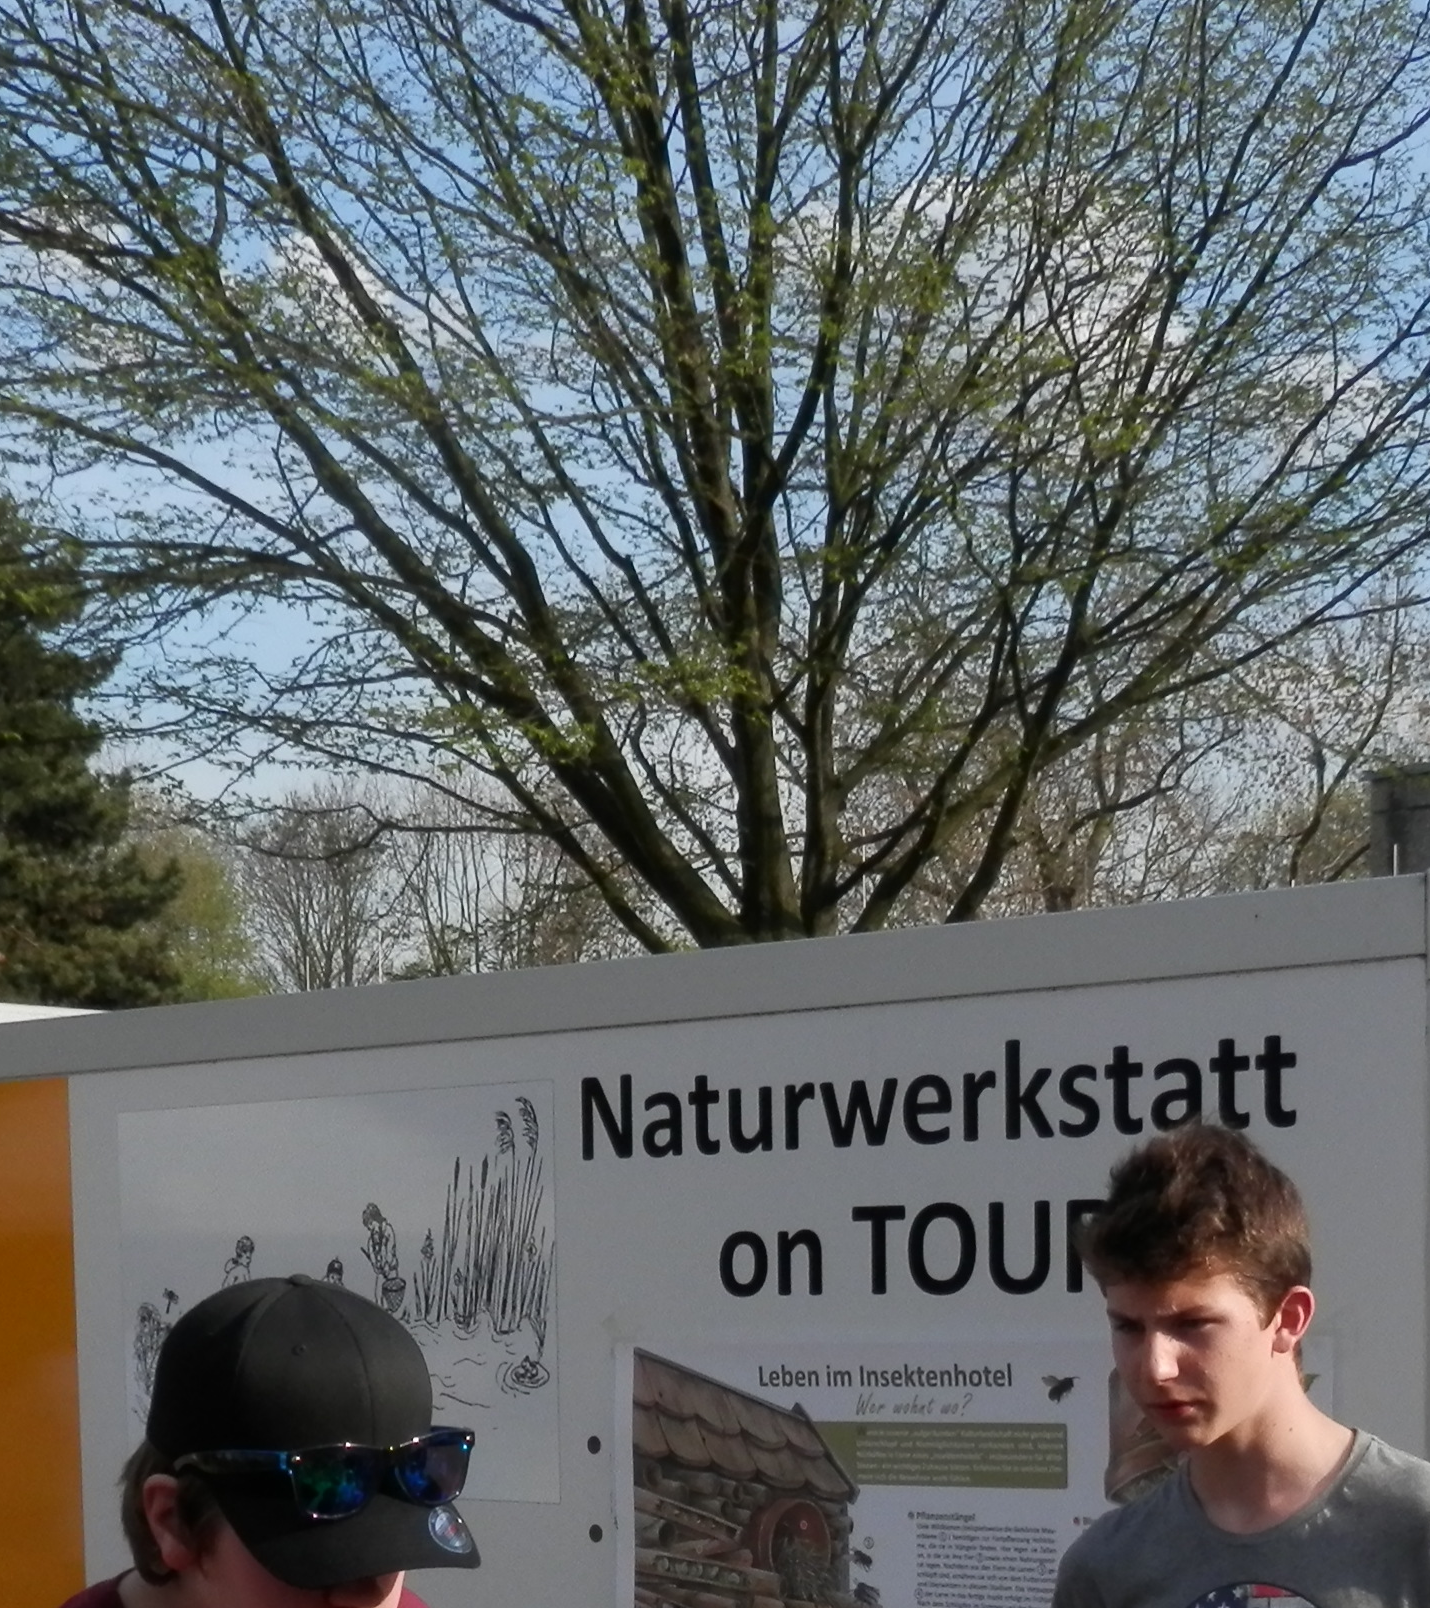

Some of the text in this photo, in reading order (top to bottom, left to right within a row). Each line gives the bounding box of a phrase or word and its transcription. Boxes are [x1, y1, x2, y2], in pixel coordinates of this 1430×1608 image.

[580, 1034, 1298, 1161] Naturwerkstatt
[718, 1227, 823, 1298] on
[758, 1363, 1013, 1387] Leben im Insektenhotel
[855, 1393, 886, 1416] Wer
